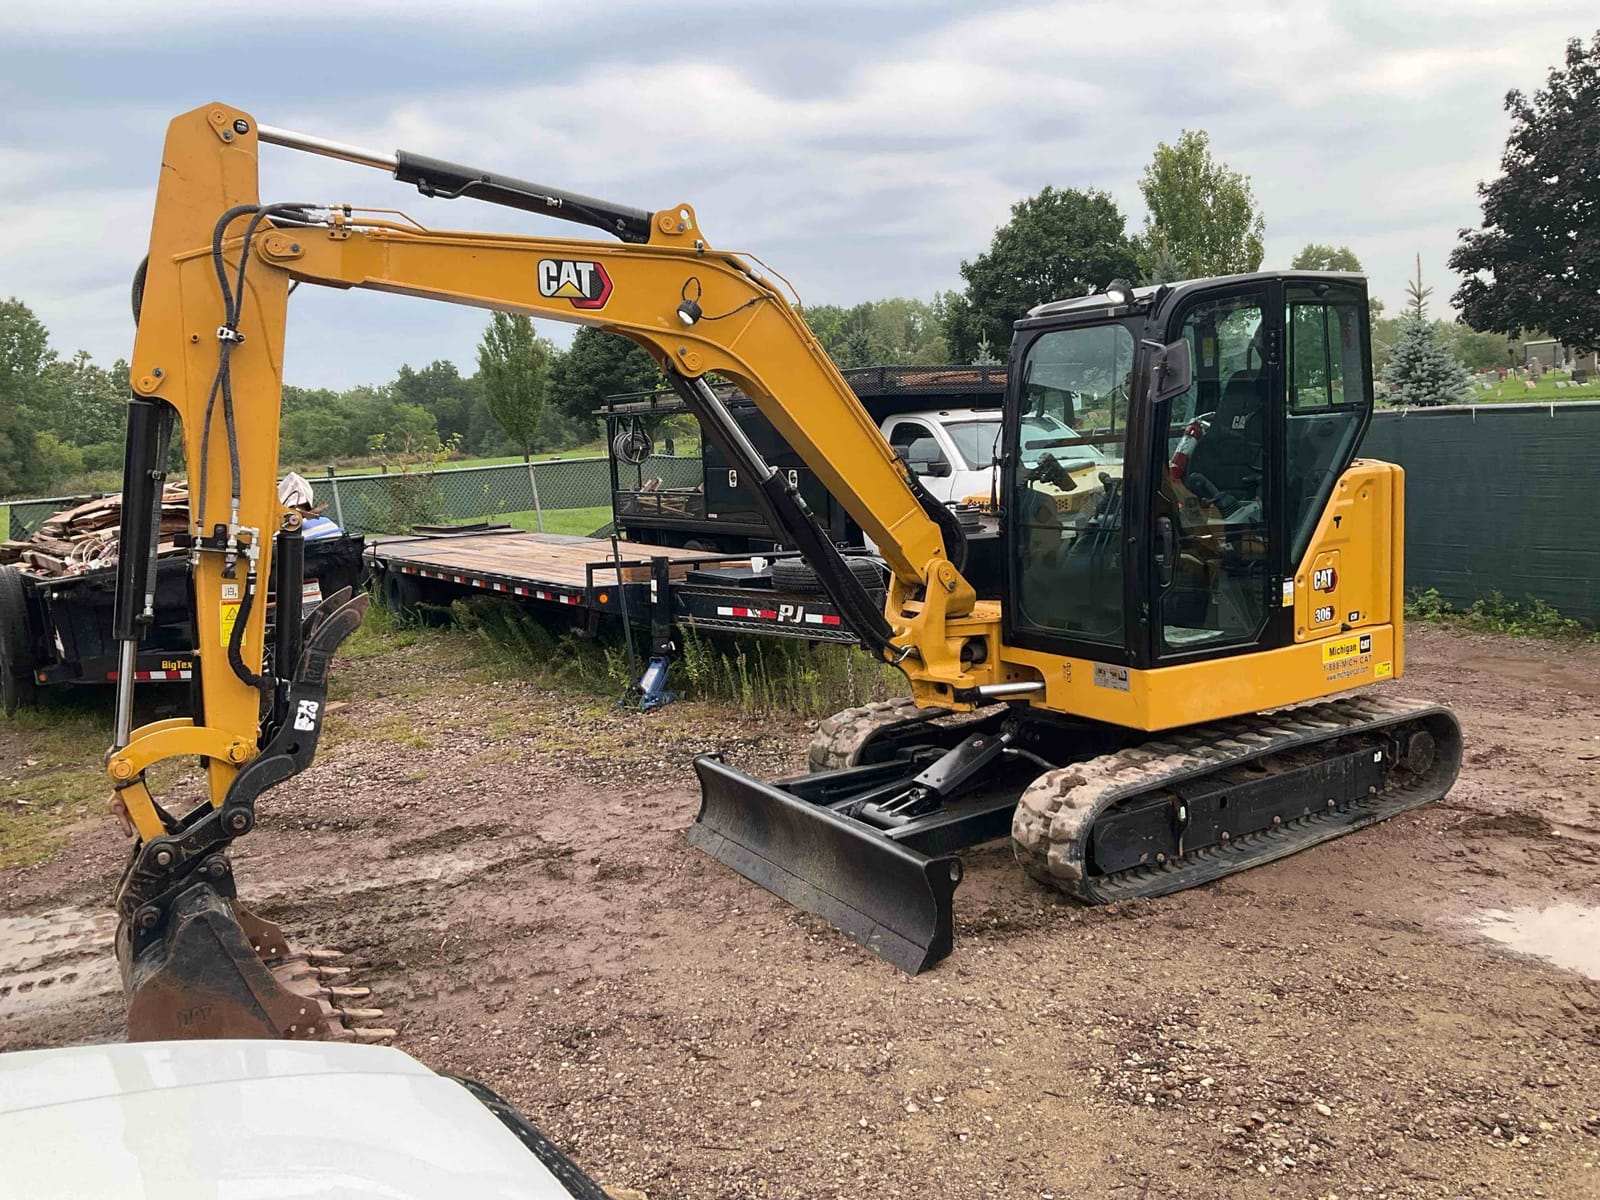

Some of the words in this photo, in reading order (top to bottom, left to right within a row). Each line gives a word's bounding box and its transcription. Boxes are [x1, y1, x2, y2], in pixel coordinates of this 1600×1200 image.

[539, 260, 594, 298] CAT
[1314, 569, 1333, 590] CAT
[777, 604, 804, 623] PJ
[1315, 606, 1331, 623] 306
[1328, 643, 1357, 657] Michigan
[1360, 639, 1370, 650] CAT
[1359, 654, 1372, 664] CAT
